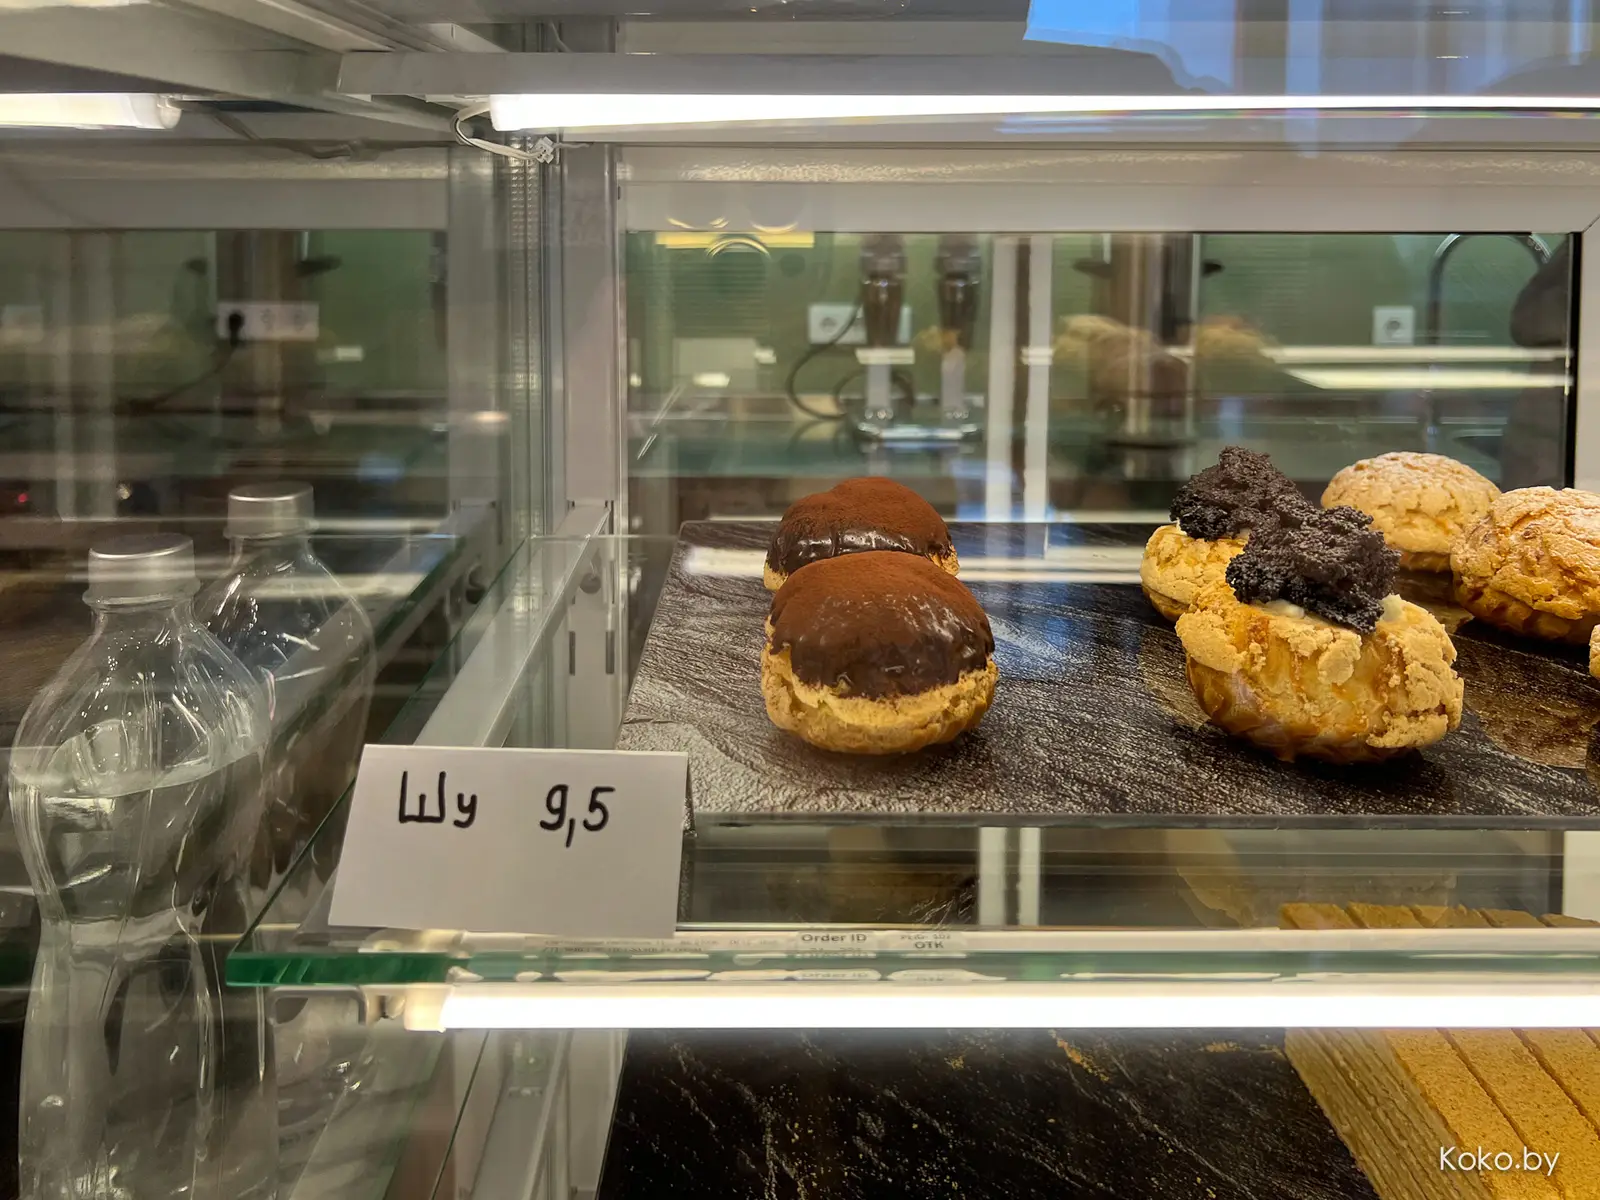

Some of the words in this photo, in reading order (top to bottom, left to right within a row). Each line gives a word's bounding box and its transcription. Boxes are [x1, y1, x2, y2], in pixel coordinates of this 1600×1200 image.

[398, 770, 478, 828] Шу
[539, 783, 616, 848] 9,5
[801, 933, 846, 942] Order
[851, 933, 867, 942] ID
